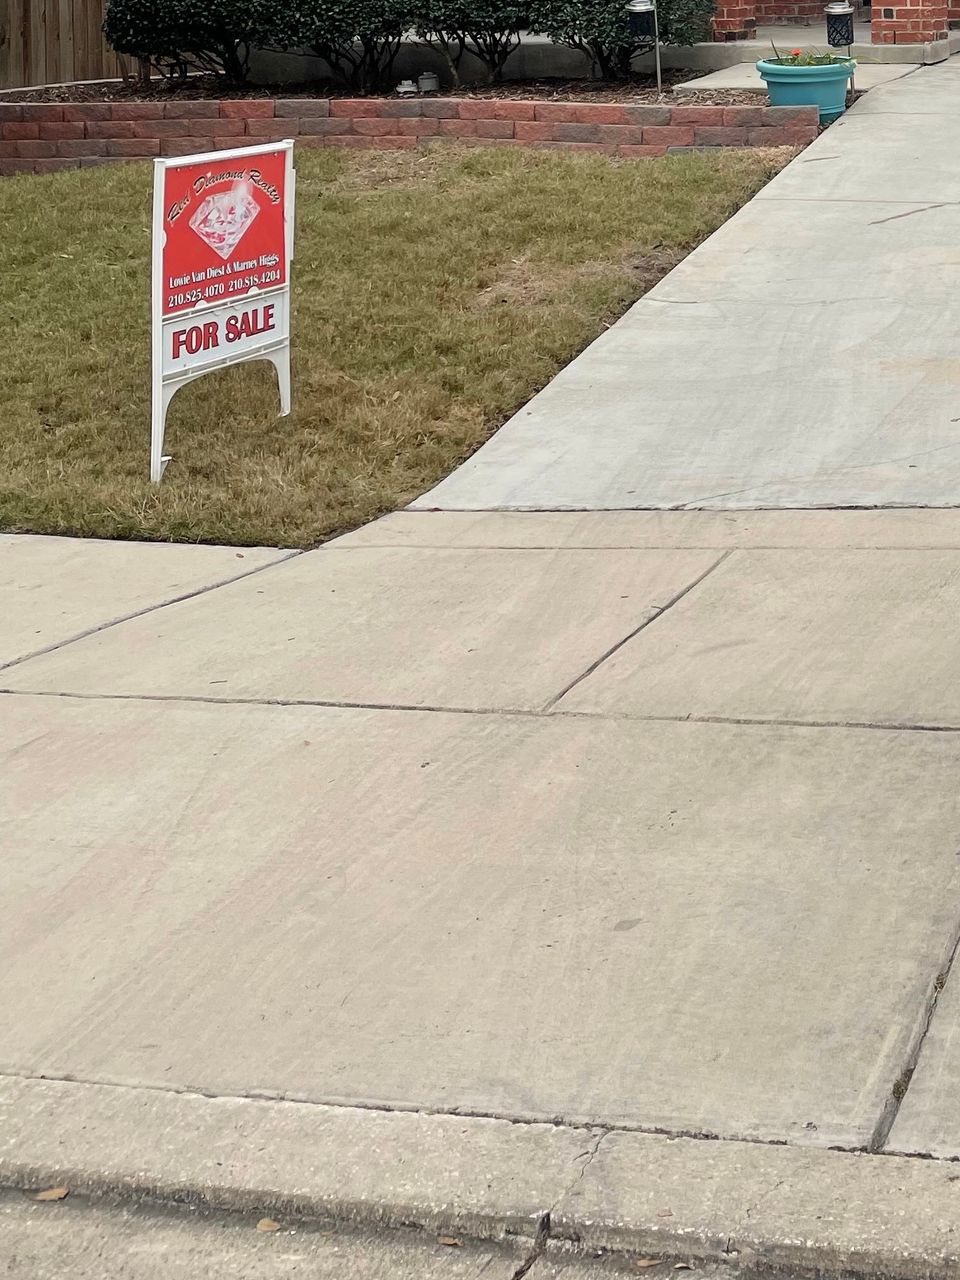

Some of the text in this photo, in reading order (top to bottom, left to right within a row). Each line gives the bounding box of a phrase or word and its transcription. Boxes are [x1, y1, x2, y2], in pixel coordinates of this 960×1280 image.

[167, 168, 281, 222] Red Diamond Realty
[192, 271, 206, 283] Van
[207, 265, 225, 280] Diest
[226, 264, 232, 275] &
[168, 282, 225, 308] 210.825.4070
[172, 303, 276, 360] FOR SALE
